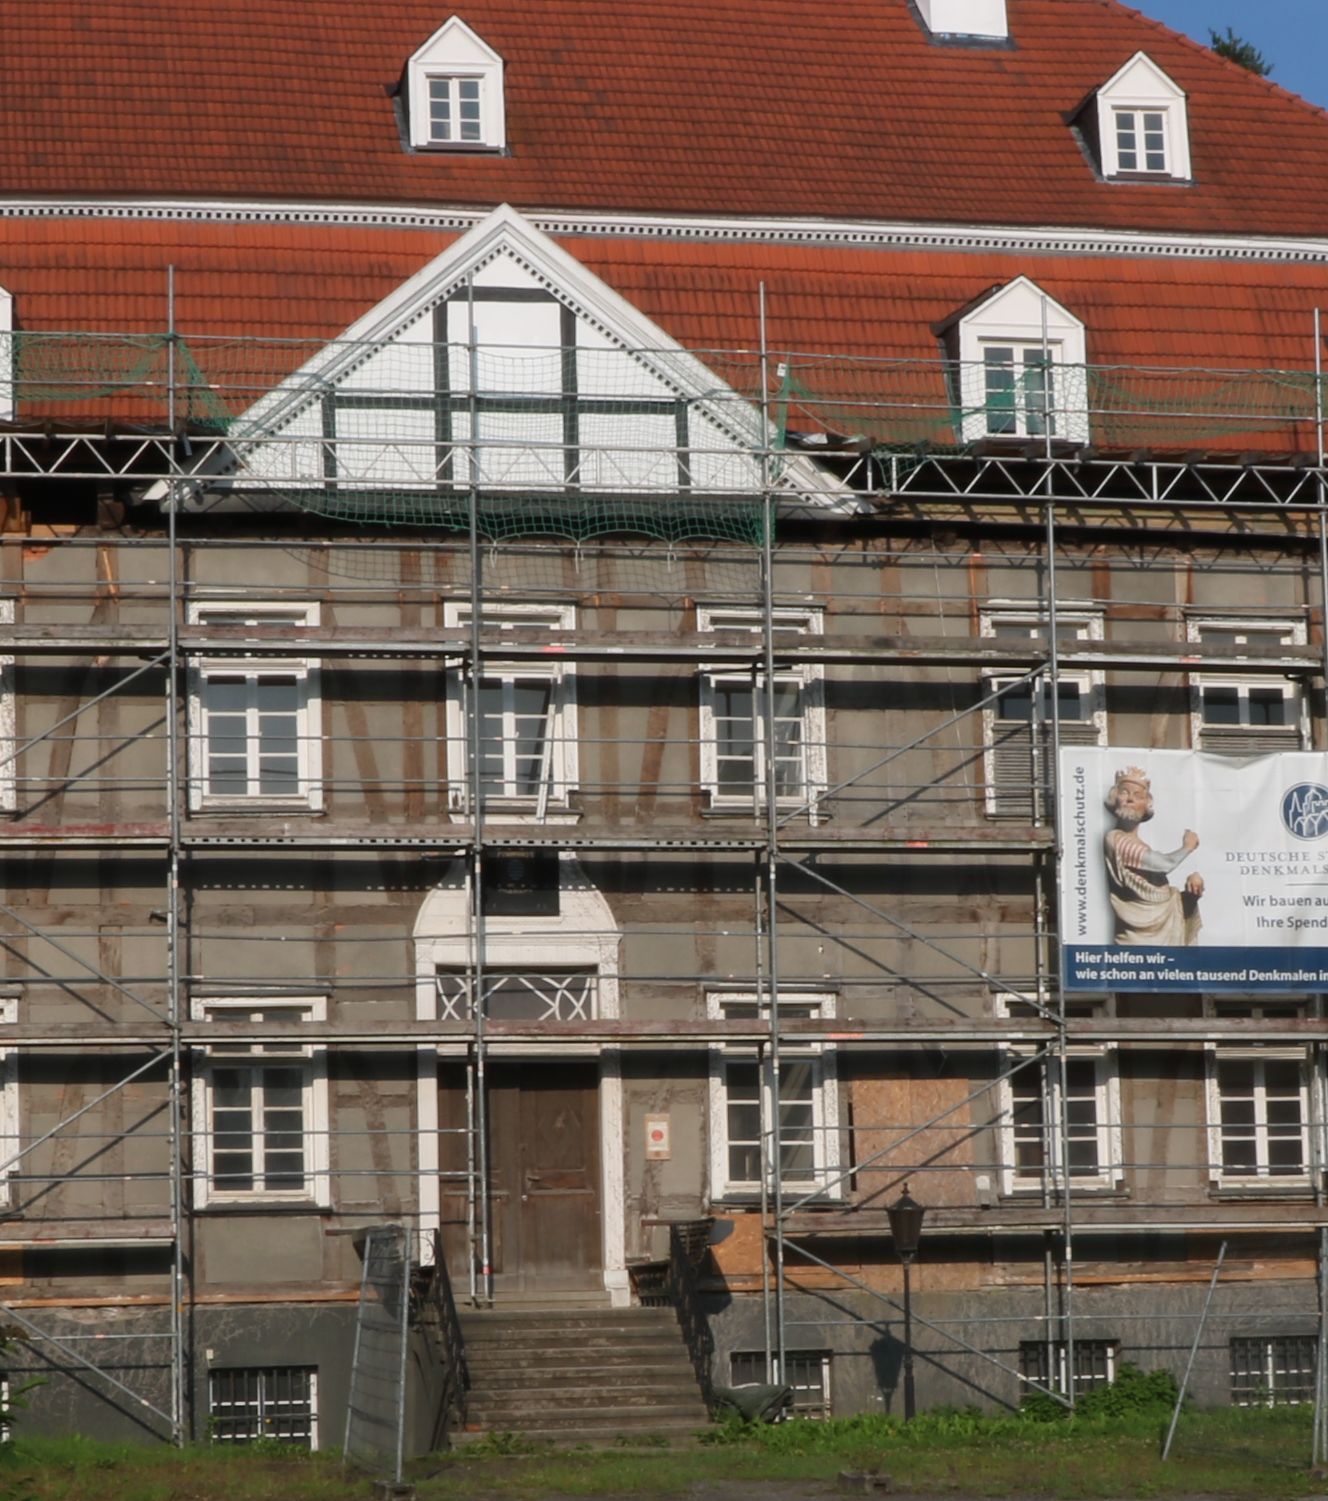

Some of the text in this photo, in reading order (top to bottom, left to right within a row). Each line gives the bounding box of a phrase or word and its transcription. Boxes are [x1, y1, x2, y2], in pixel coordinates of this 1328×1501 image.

[1073, 766, 1087, 937] www.denkmalschutz.de
[1225, 851, 1311, 862] DEUTSCHE
[1242, 895, 1266, 907] Wir
[1269, 895, 1312, 907] bauen
[1256, 916, 1284, 928] Ihre
[1075, 952, 1102, 963] Hier
[1104, 952, 1144, 964] helfen
[1146, 952, 1166, 964] wir
[1075, 968, 1098, 980] wie
[1099, 968, 1137, 980] schon
[1139, 970, 1155, 980] an
[1157, 968, 1194, 981] vielen
[1196, 969, 1247, 981] tausend
[1249, 969, 1317, 981] Denkmalen
